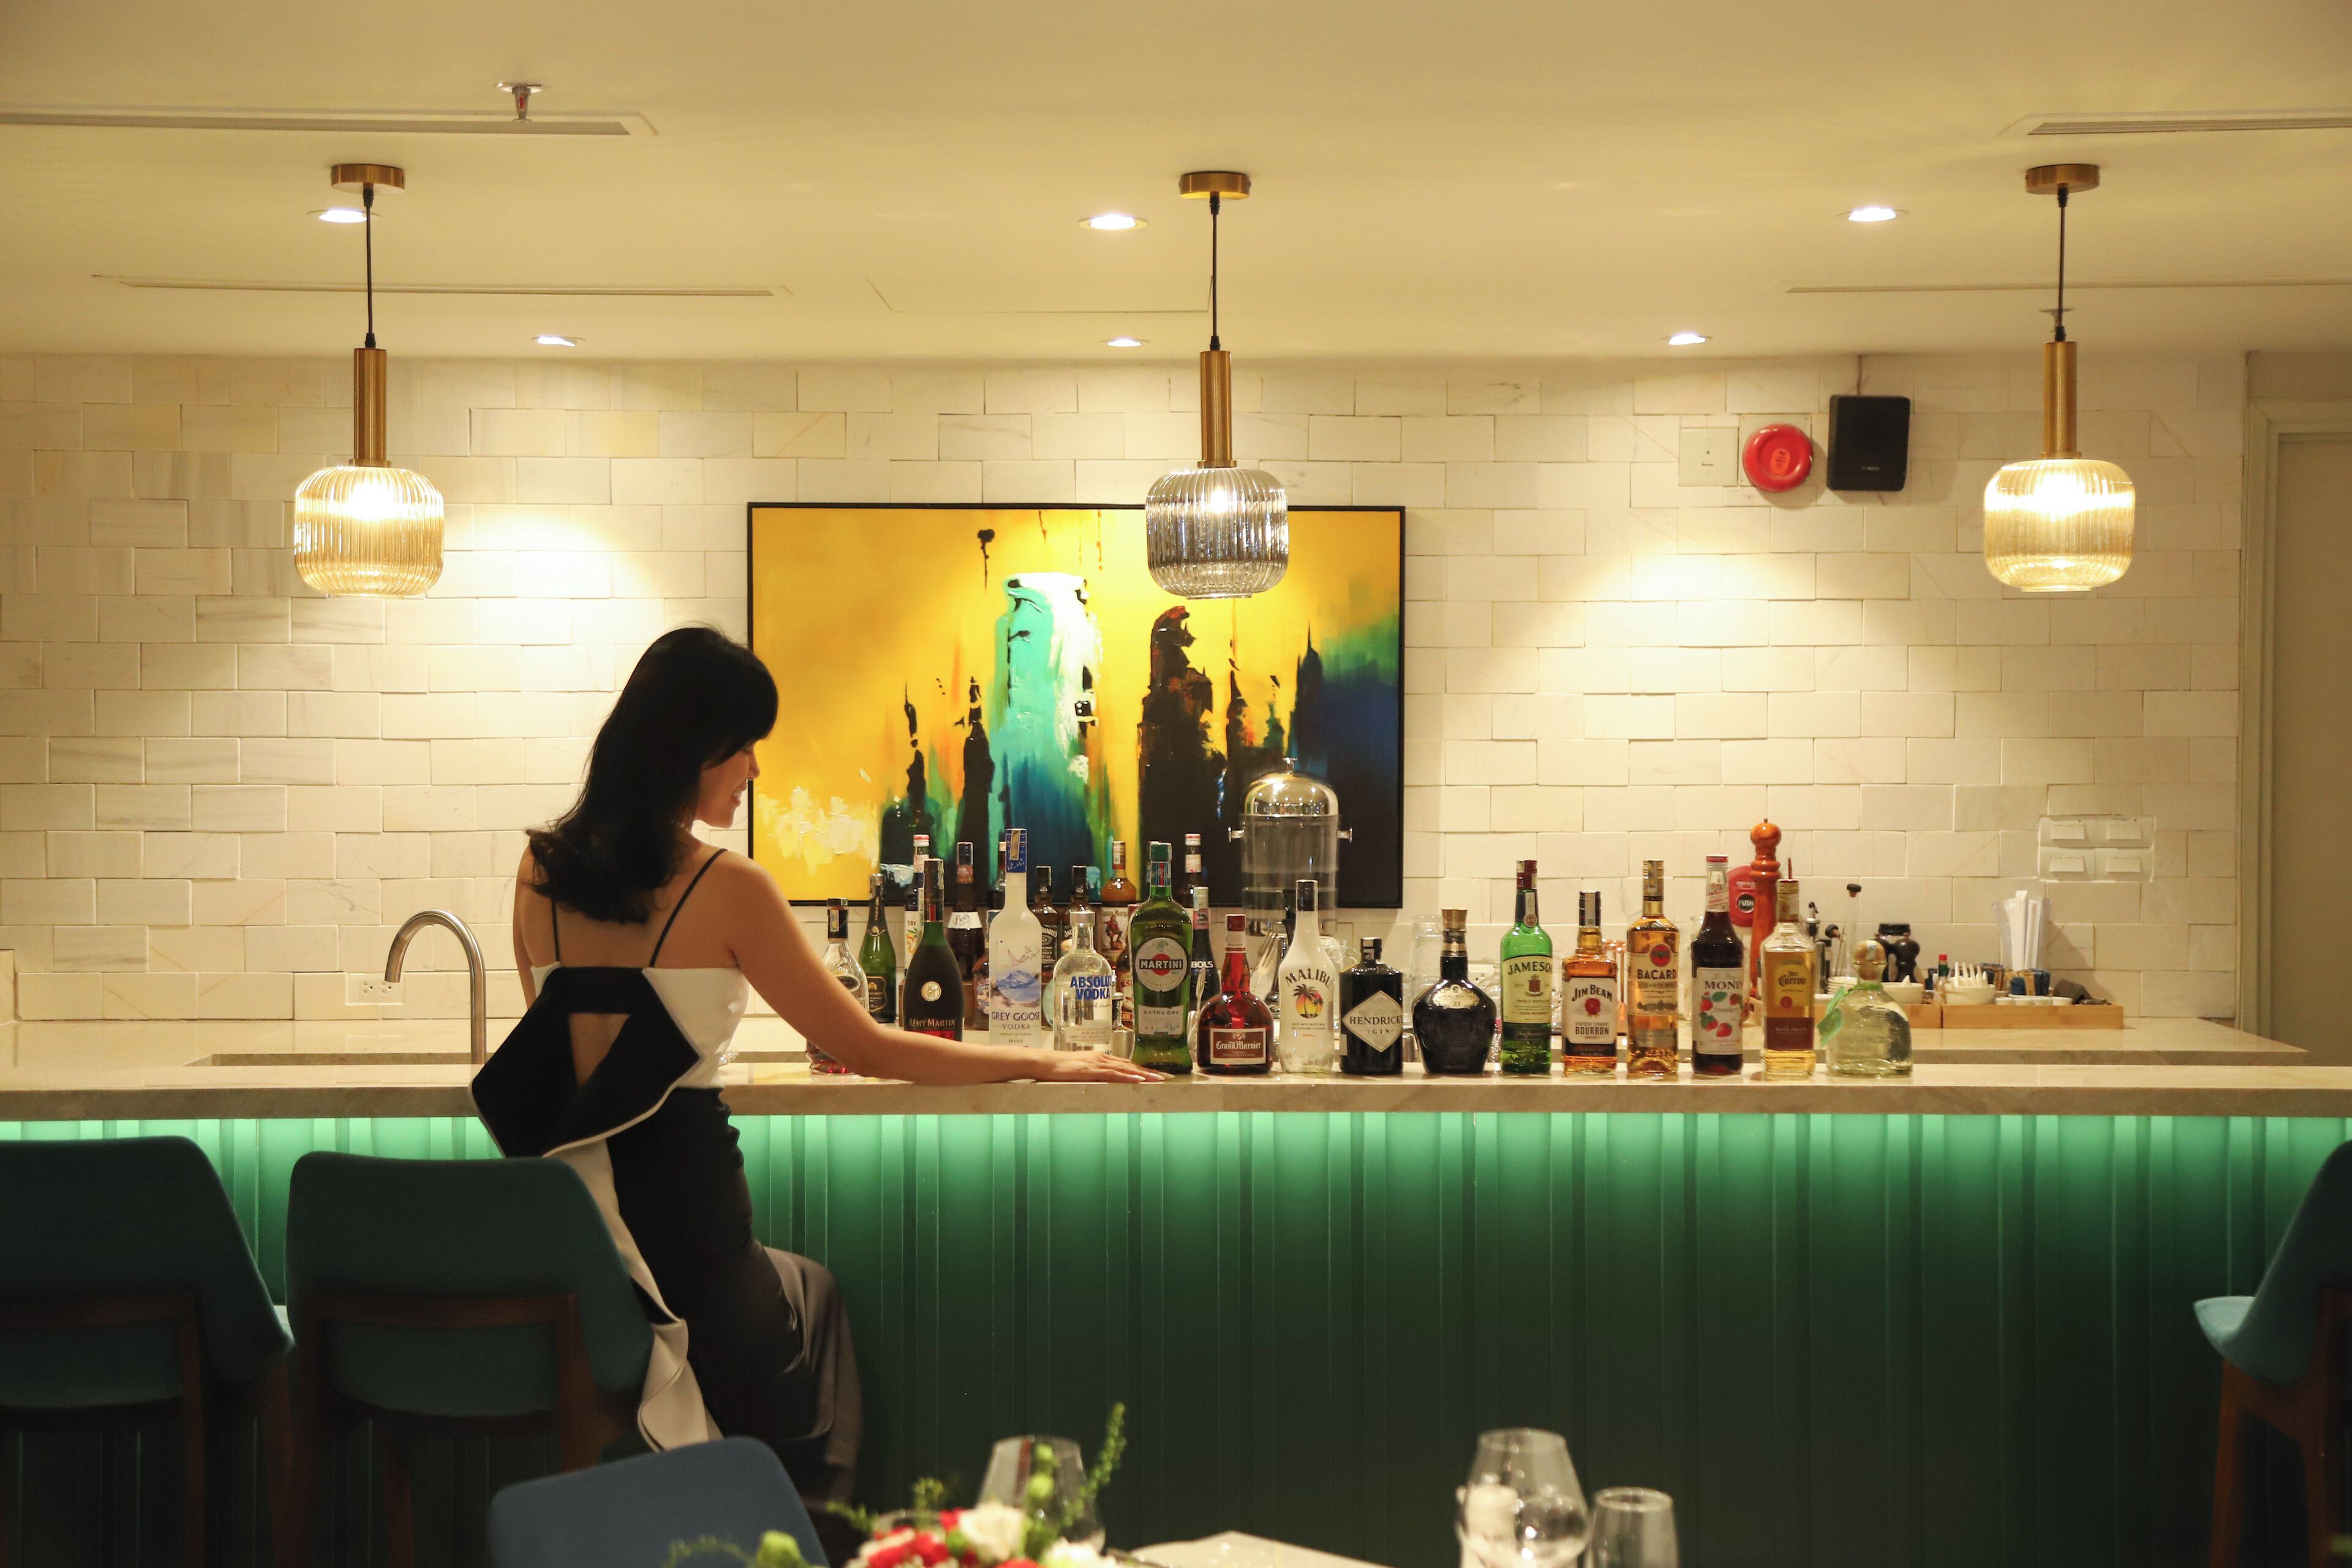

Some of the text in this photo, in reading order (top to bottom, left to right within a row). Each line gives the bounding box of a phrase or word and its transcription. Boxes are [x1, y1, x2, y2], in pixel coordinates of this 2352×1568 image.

[1140, 960, 1182, 969] MARTINI
[1285, 968, 1333, 988] MALIBU
[1637, 969, 1676, 980] BACARD
[1705, 981, 1743, 990] MONIN
[1778, 974, 1806, 987] Cuervo
[1075, 987, 1110, 1000] VODKA
[1572, 984, 1613, 1002] JIM BEAM
[992, 1011, 1040, 1022] GREY GOOSE
[927, 1019, 956, 1027] MARTIN
[1575, 1027, 1610, 1035] BOURBON
[1216, 1041, 1262, 1050] Grand Marnier
